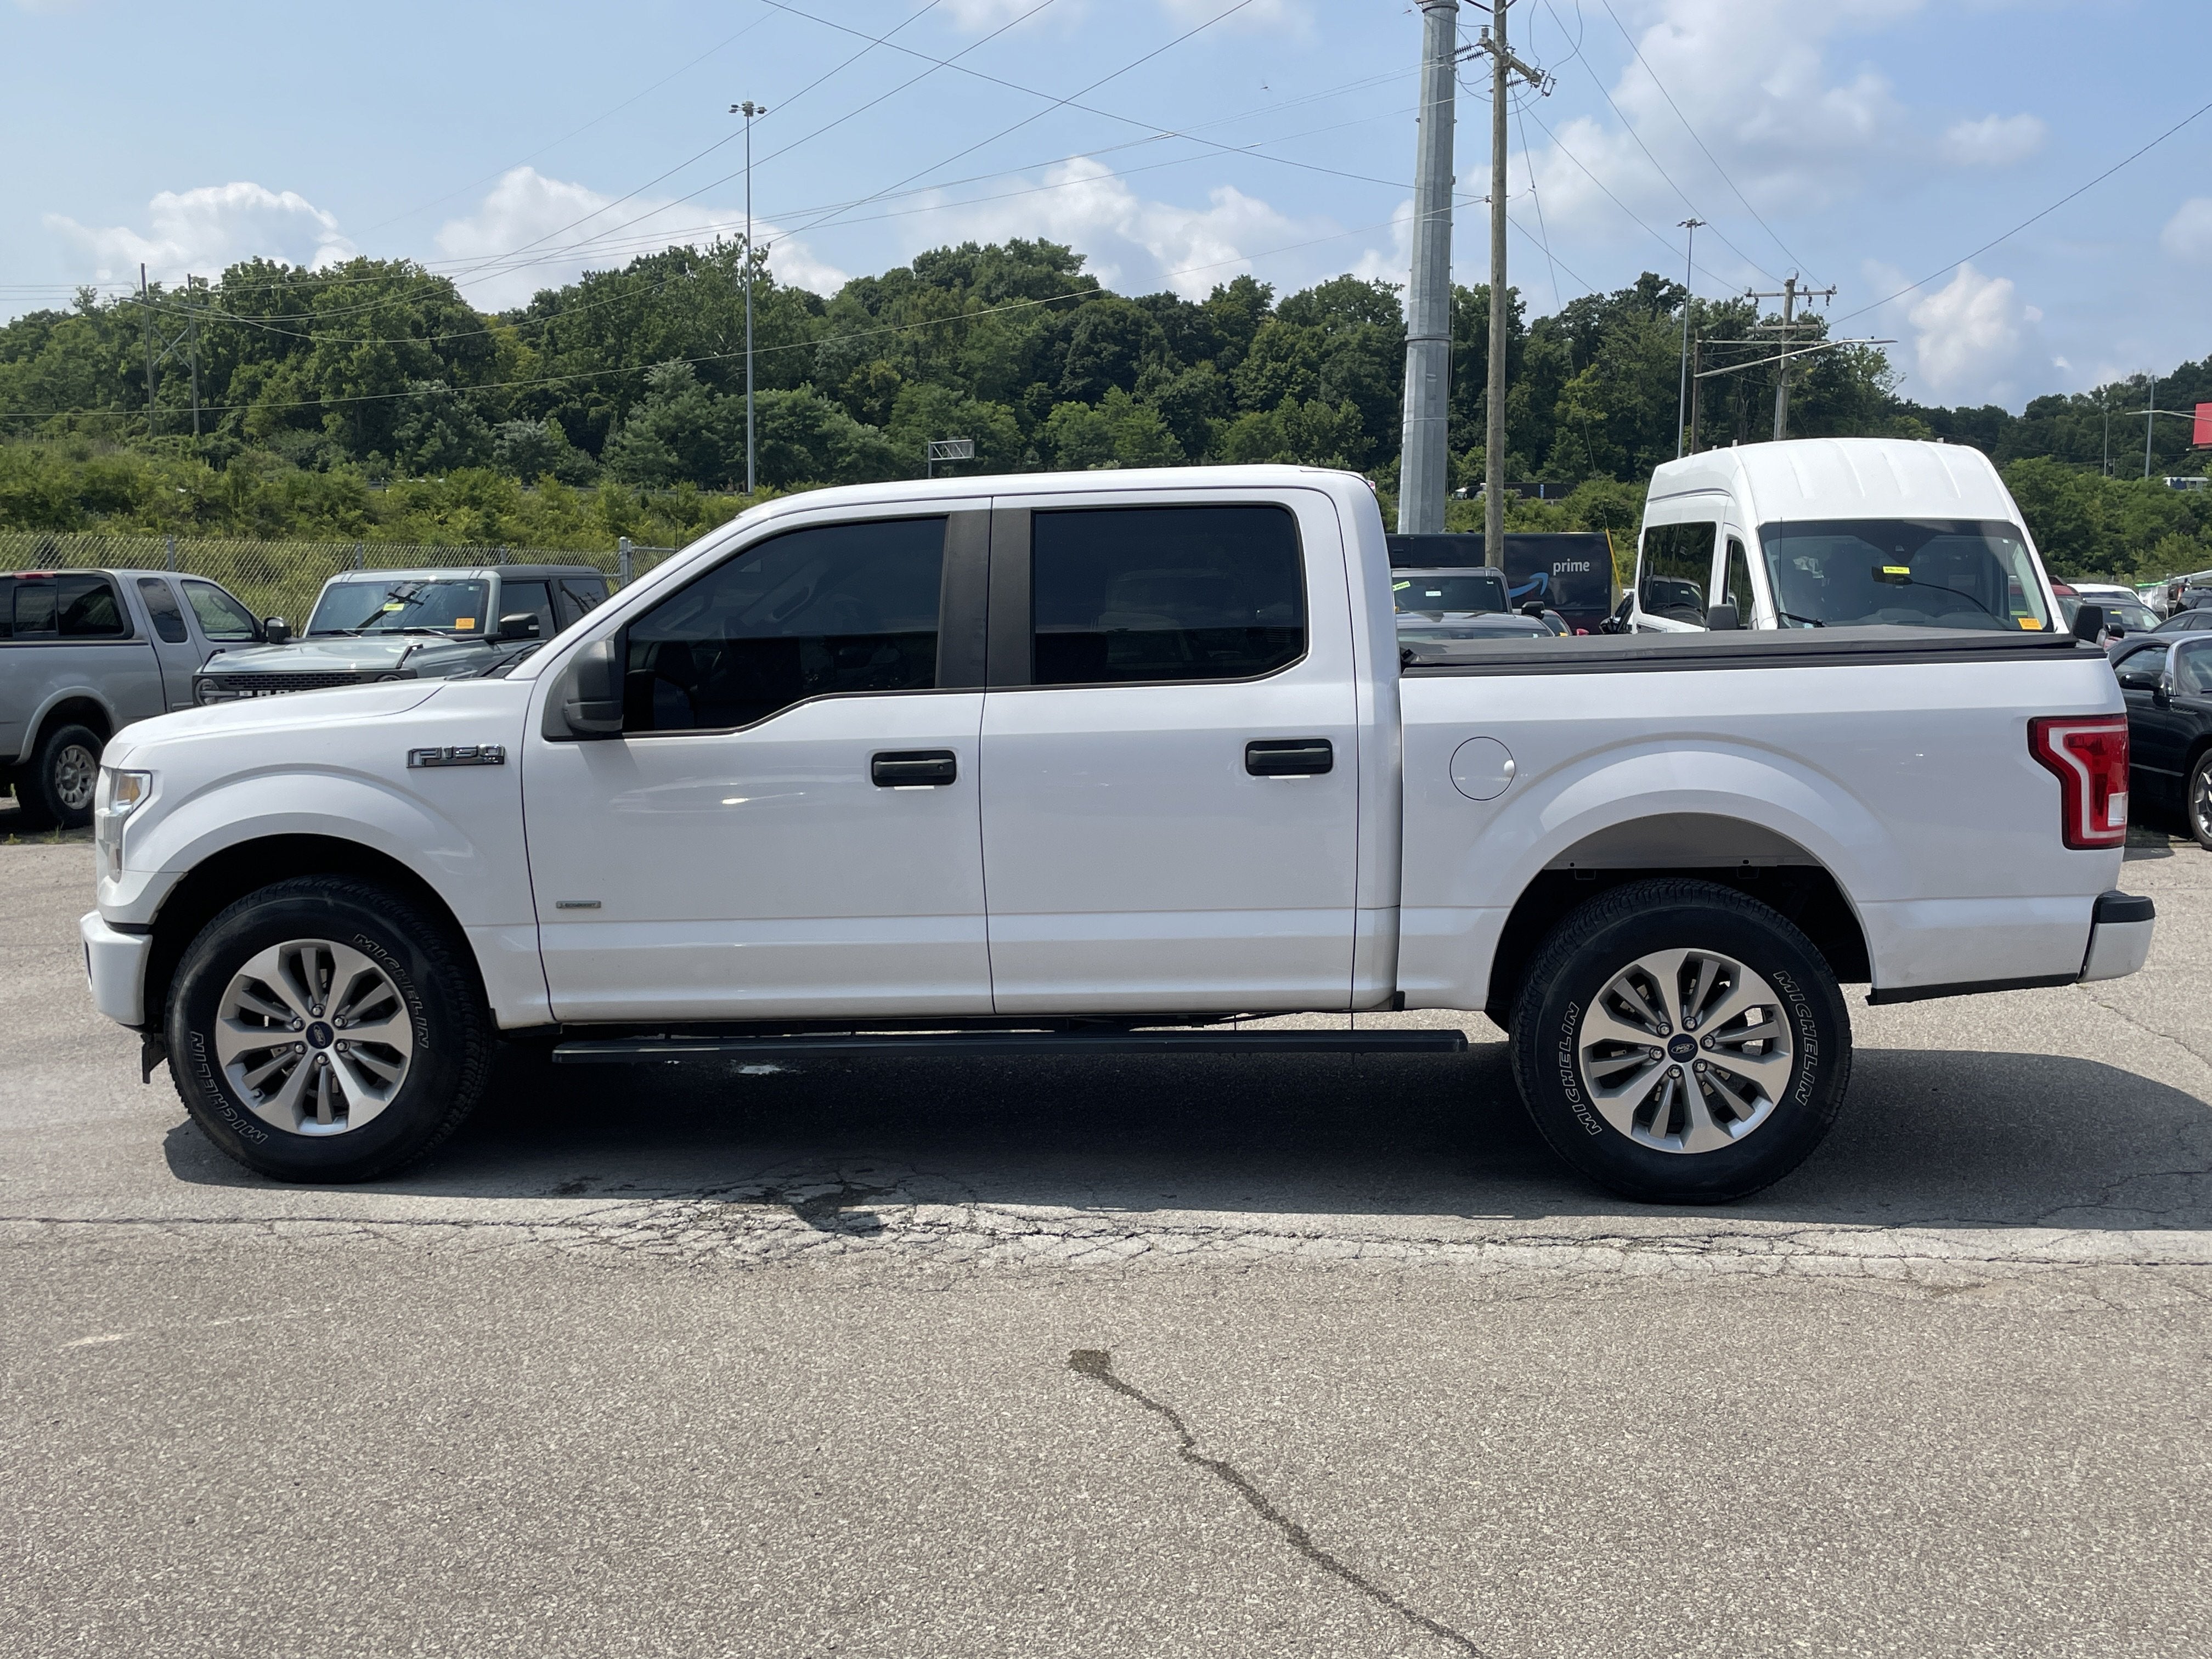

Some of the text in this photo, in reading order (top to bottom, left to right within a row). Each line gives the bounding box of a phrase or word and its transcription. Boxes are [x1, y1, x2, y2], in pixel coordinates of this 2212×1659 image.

[1553, 558, 1590, 576] prime
[354, 934, 428, 1048] MICHELIN
[1774, 970, 1818, 1106] MICHELIN
[190, 1032, 268, 1144] MICHELIN
[1560, 1002, 1602, 1136] MICHELIN
